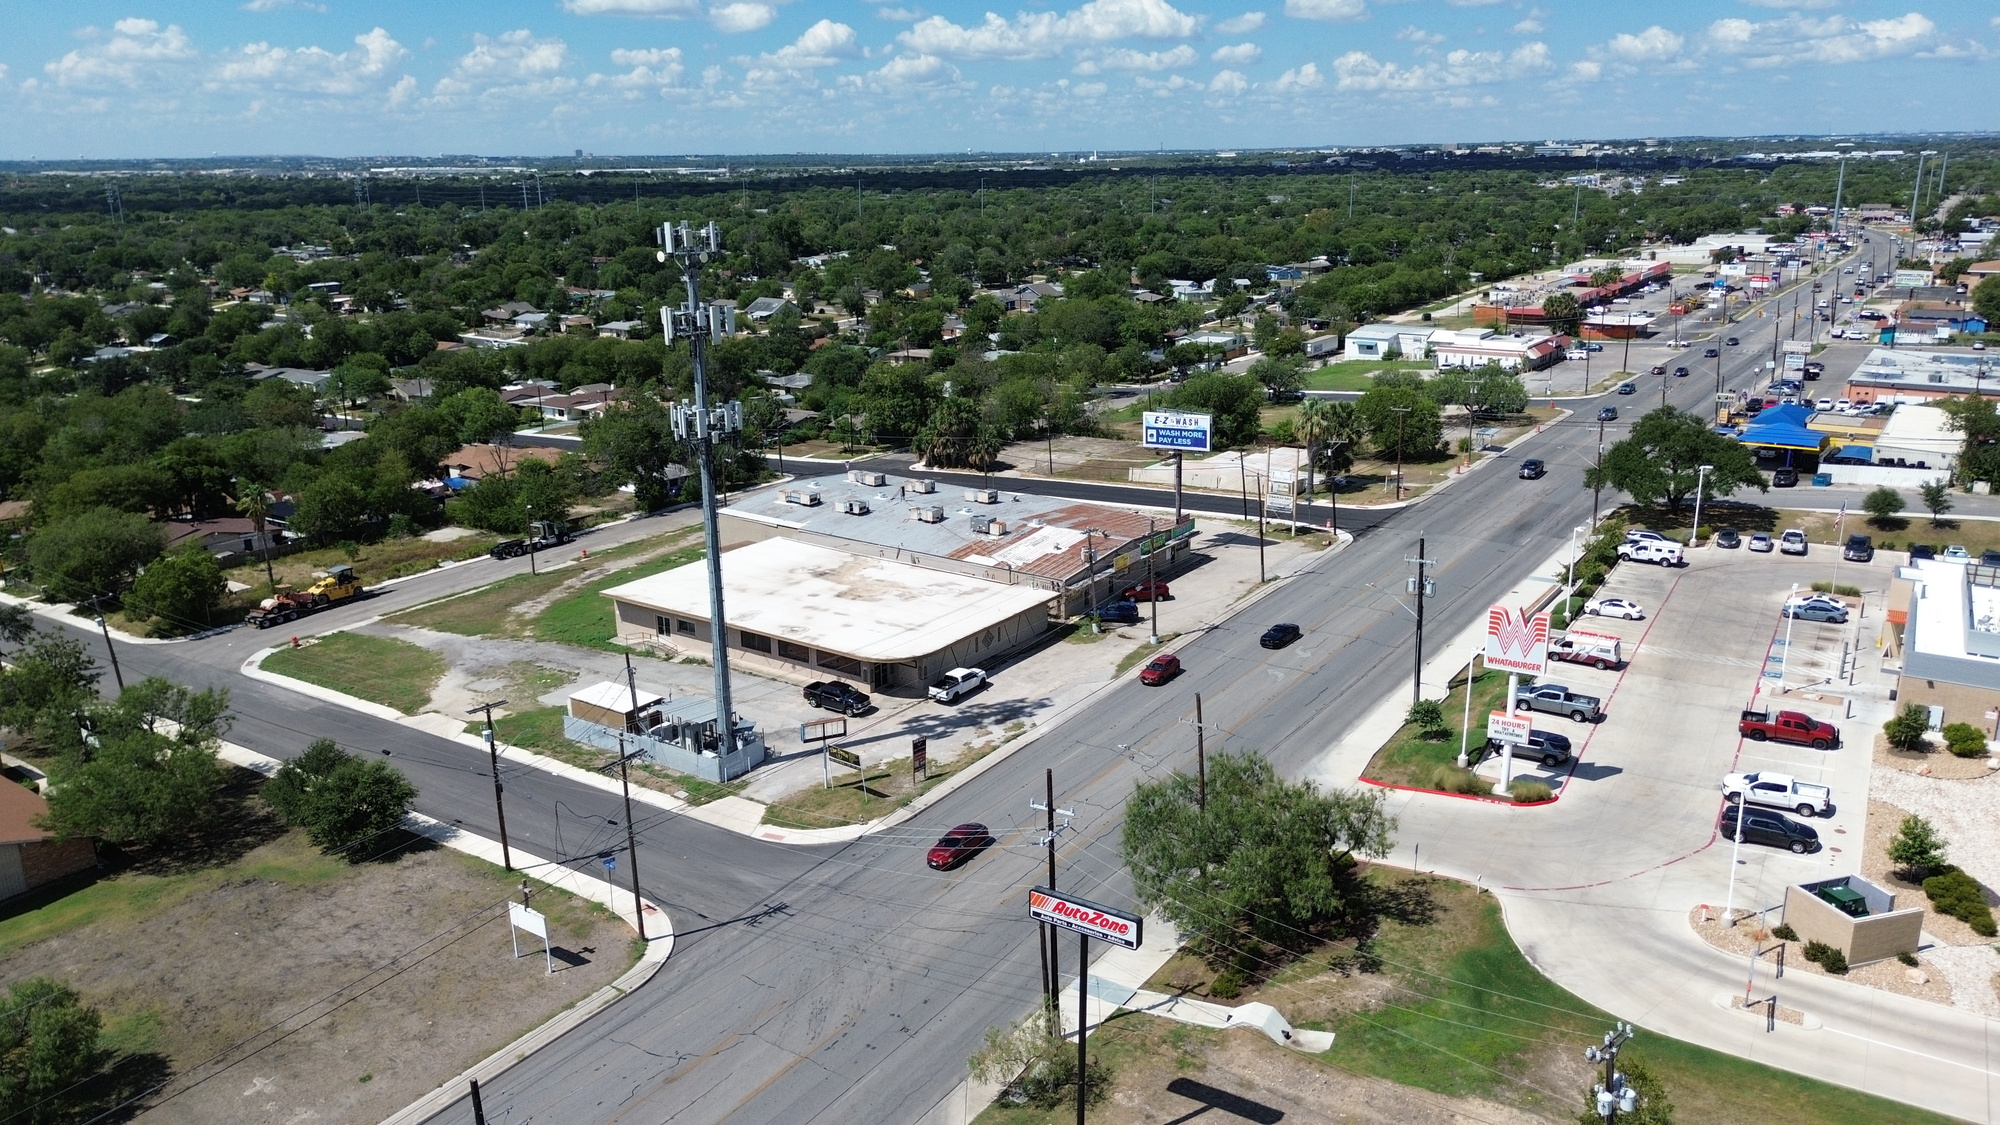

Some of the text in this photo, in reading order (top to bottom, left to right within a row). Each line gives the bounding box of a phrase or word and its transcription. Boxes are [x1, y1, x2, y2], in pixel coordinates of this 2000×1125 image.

[1154, 416, 1169, 424] E-Z
[1176, 418, 1199, 426] WASH
[1182, 431, 1205, 439] MORE,
[1487, 656, 1542, 671] WHATABURGER
[1501, 720, 1526, 730] HOURS
[1051, 901, 1129, 934] AutoZone
[1041, 914, 1053, 922] Auto
[1054, 917, 1067, 926] Parts
[1107, 934, 1125, 944] Advice
